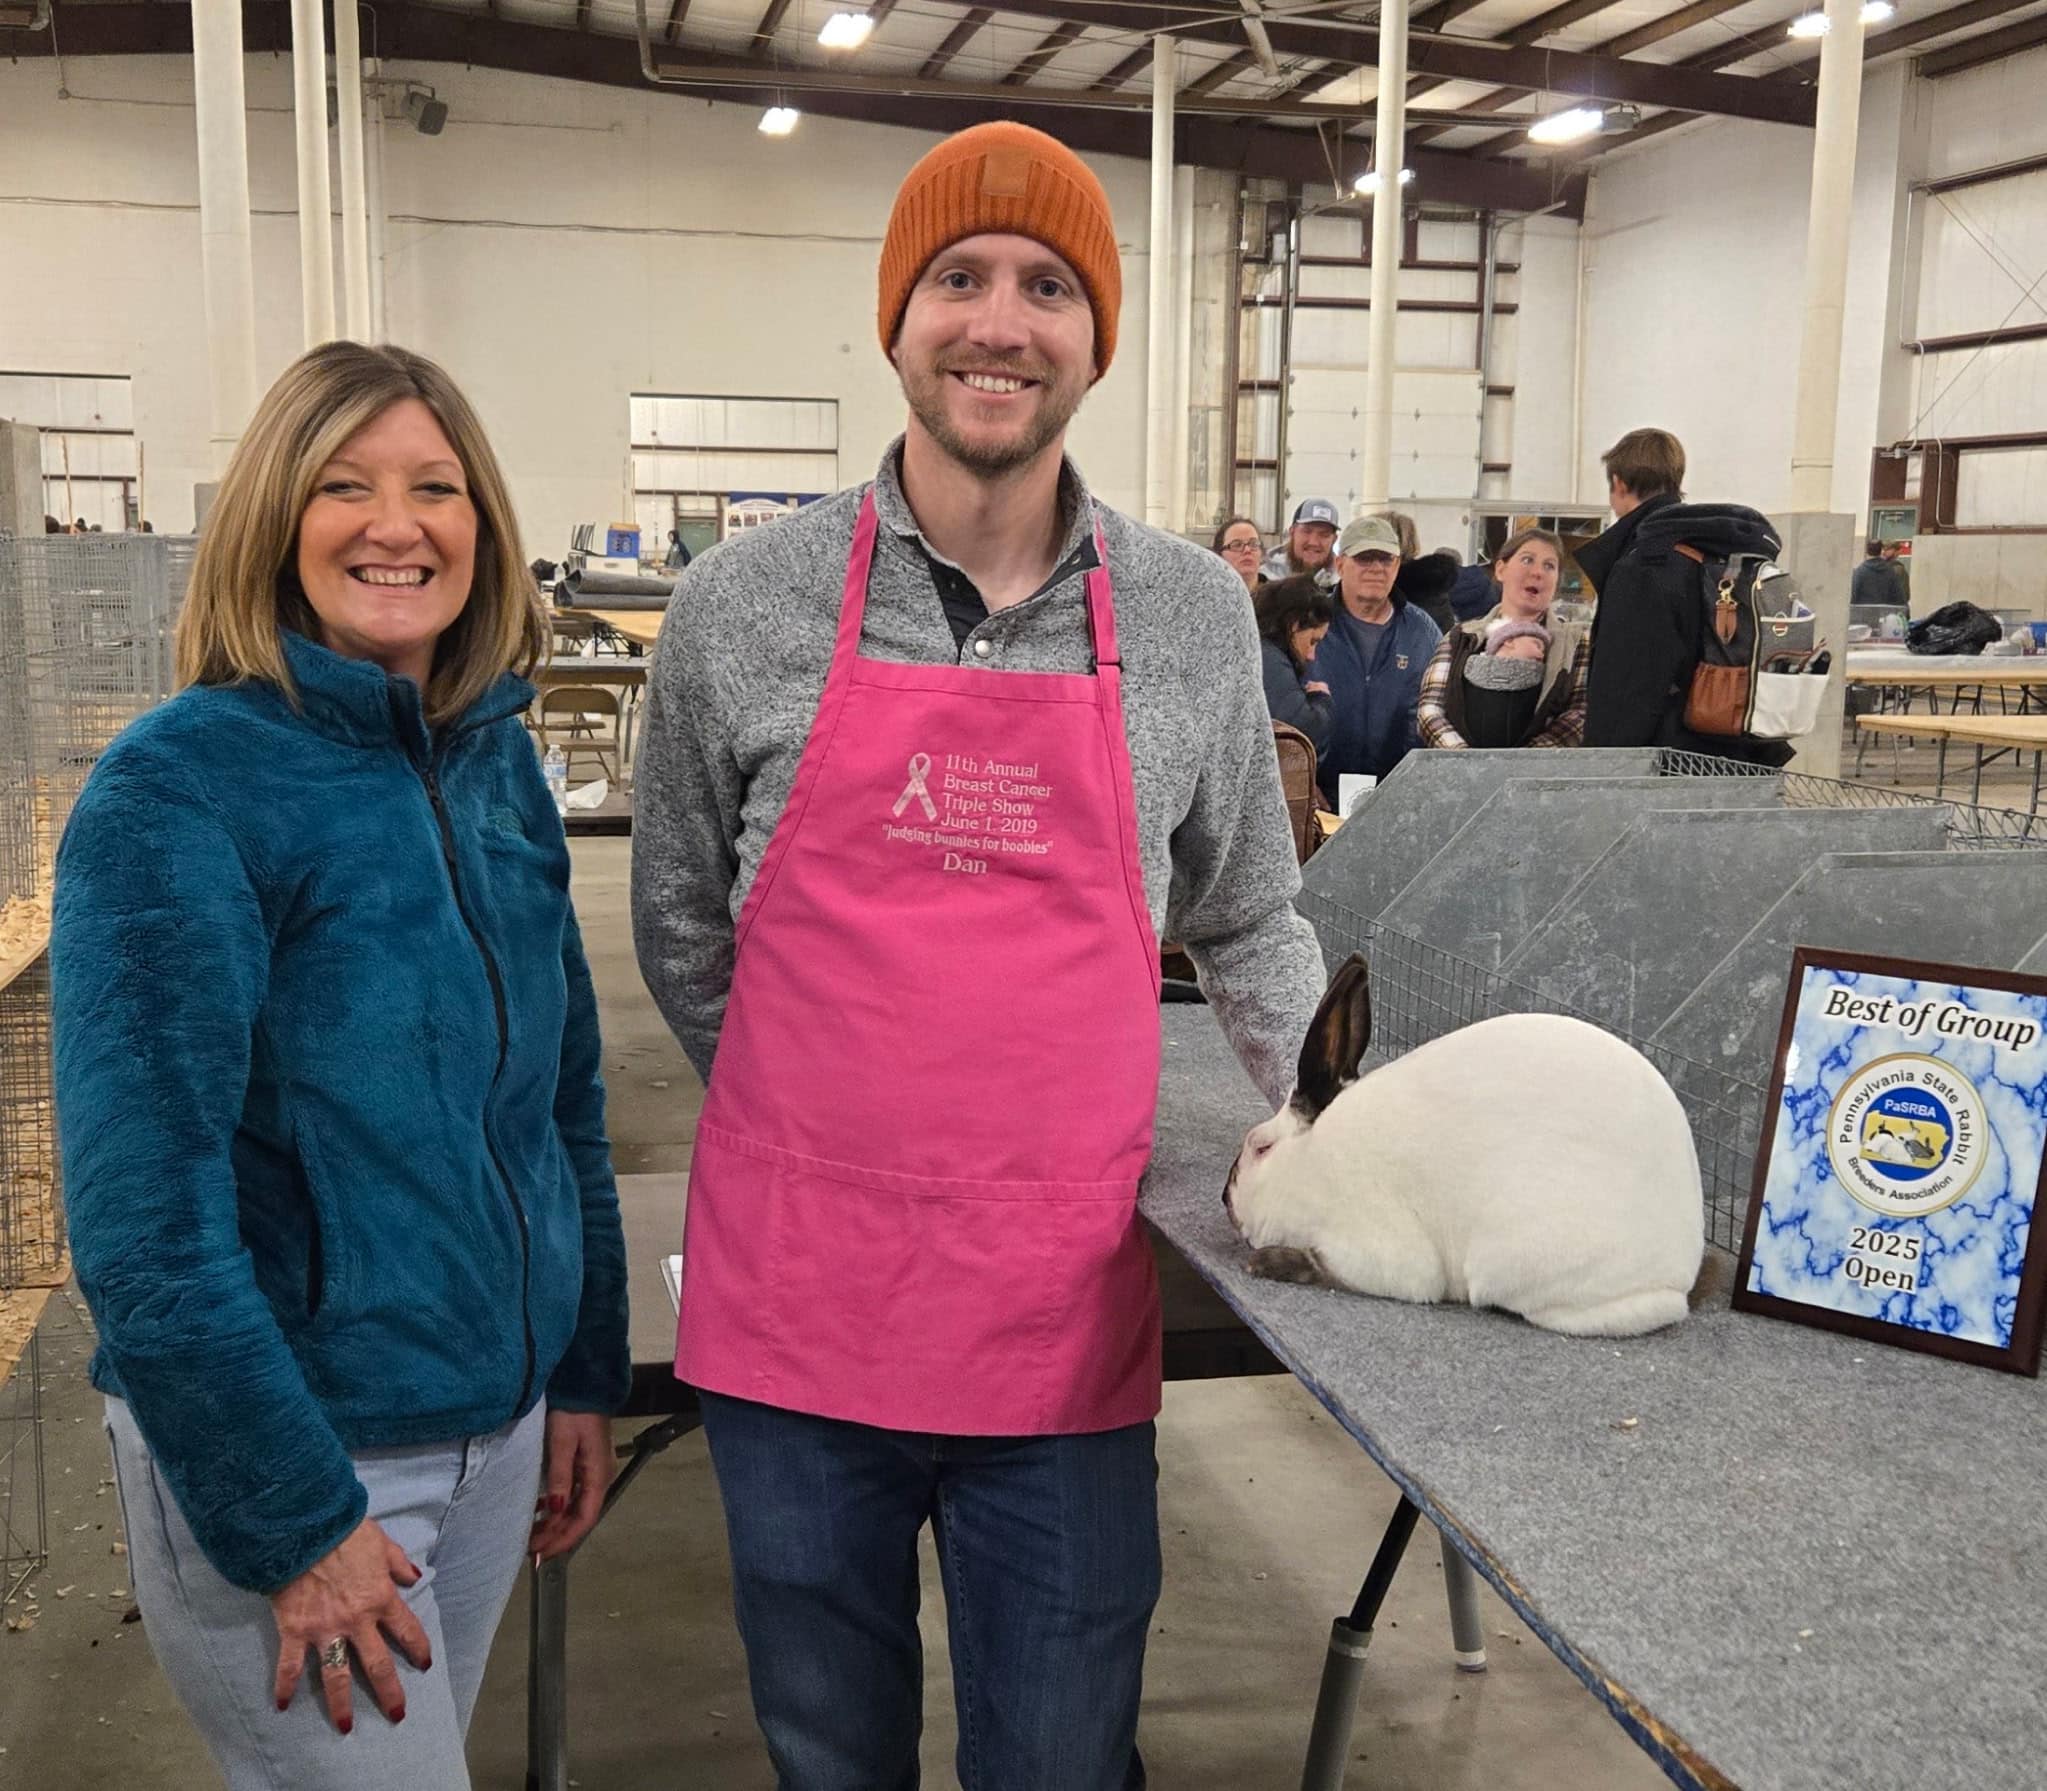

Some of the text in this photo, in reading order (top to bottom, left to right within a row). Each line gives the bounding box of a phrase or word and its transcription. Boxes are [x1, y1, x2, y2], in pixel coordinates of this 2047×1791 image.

[945, 754, 1038, 778] 11th Annual
[943, 773, 1053, 798] Breast Cancer
[943, 792, 1034, 816] Triple Show
[940, 812, 980, 830] June
[1001, 817, 1038, 834] 2019
[934, 830, 980, 849] bunnies
[982, 836, 999, 851] for
[1002, 840, 1054, 855] boobies"
[943, 852, 988, 874] Dan
[1824, 989, 2036, 1052] Best of Group
[1839, 1069, 1973, 1166] Pennsylvania State Rabbit
[1883, 1098, 1937, 1119] PaSRBA
[1847, 1156, 1953, 1201] Breeders Association
[1850, 1227, 1920, 1261] 2025
[1845, 1257, 1914, 1291] Open
